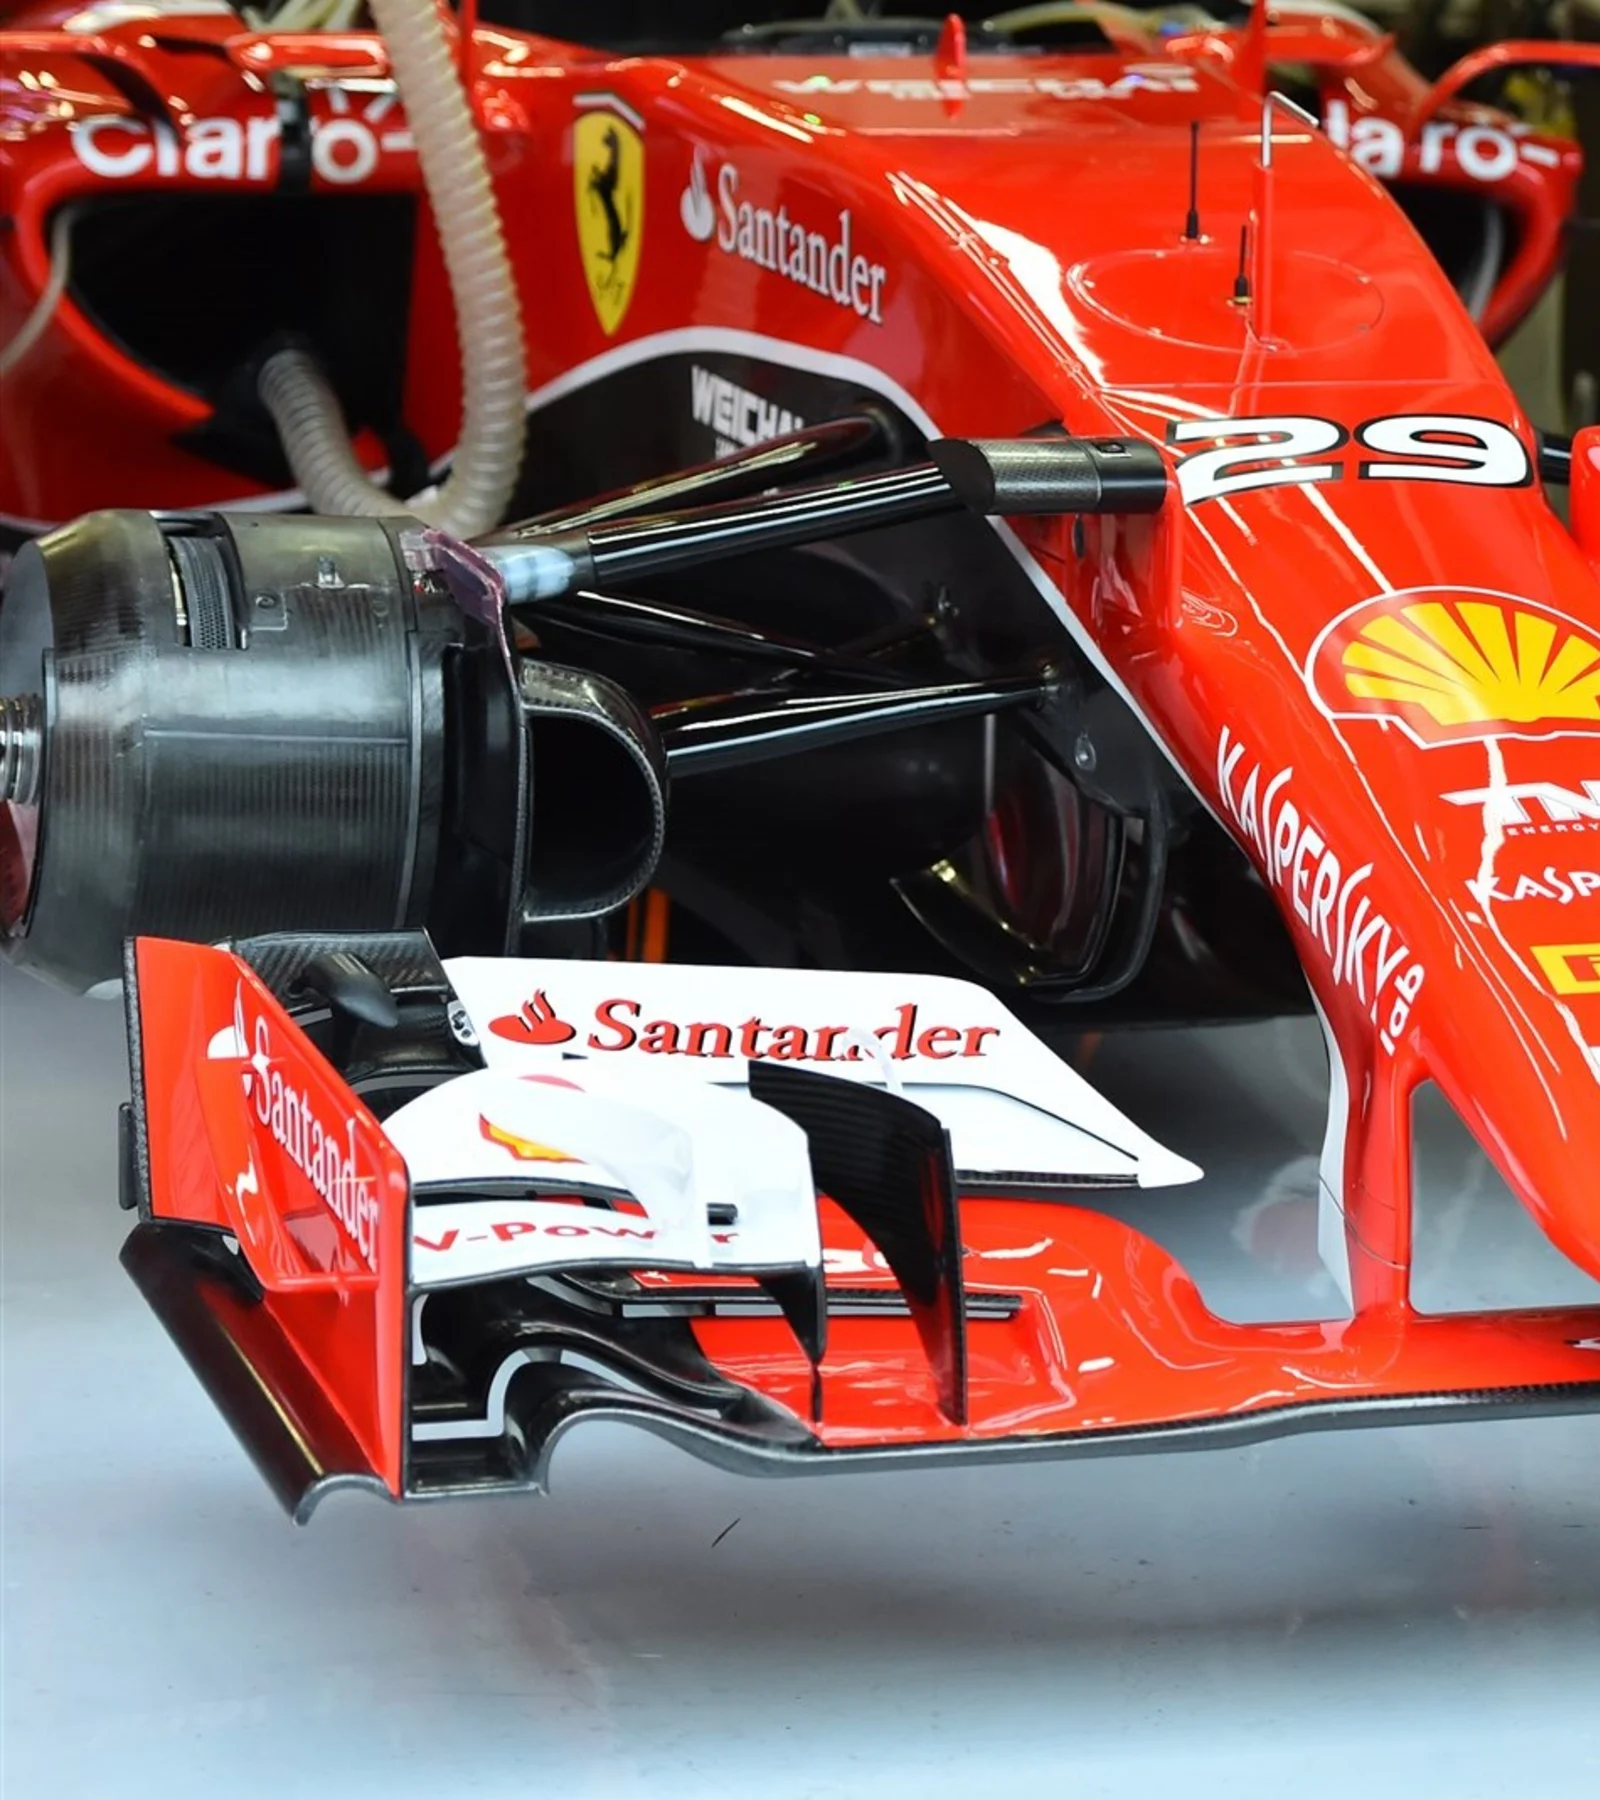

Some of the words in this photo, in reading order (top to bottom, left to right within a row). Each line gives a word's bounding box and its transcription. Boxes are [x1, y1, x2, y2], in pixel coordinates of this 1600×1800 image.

[717, 162, 887, 326] Santander
[1166, 413, 1534, 508] 29
[1216, 724, 1410, 1026] KASPERSKY
[1379, 963, 1425, 1058] lab
[1506, 822, 1600, 837] ENERGY
[253, 1015, 379, 1274] Santander
[413, 1221, 739, 1252] V-Powr
